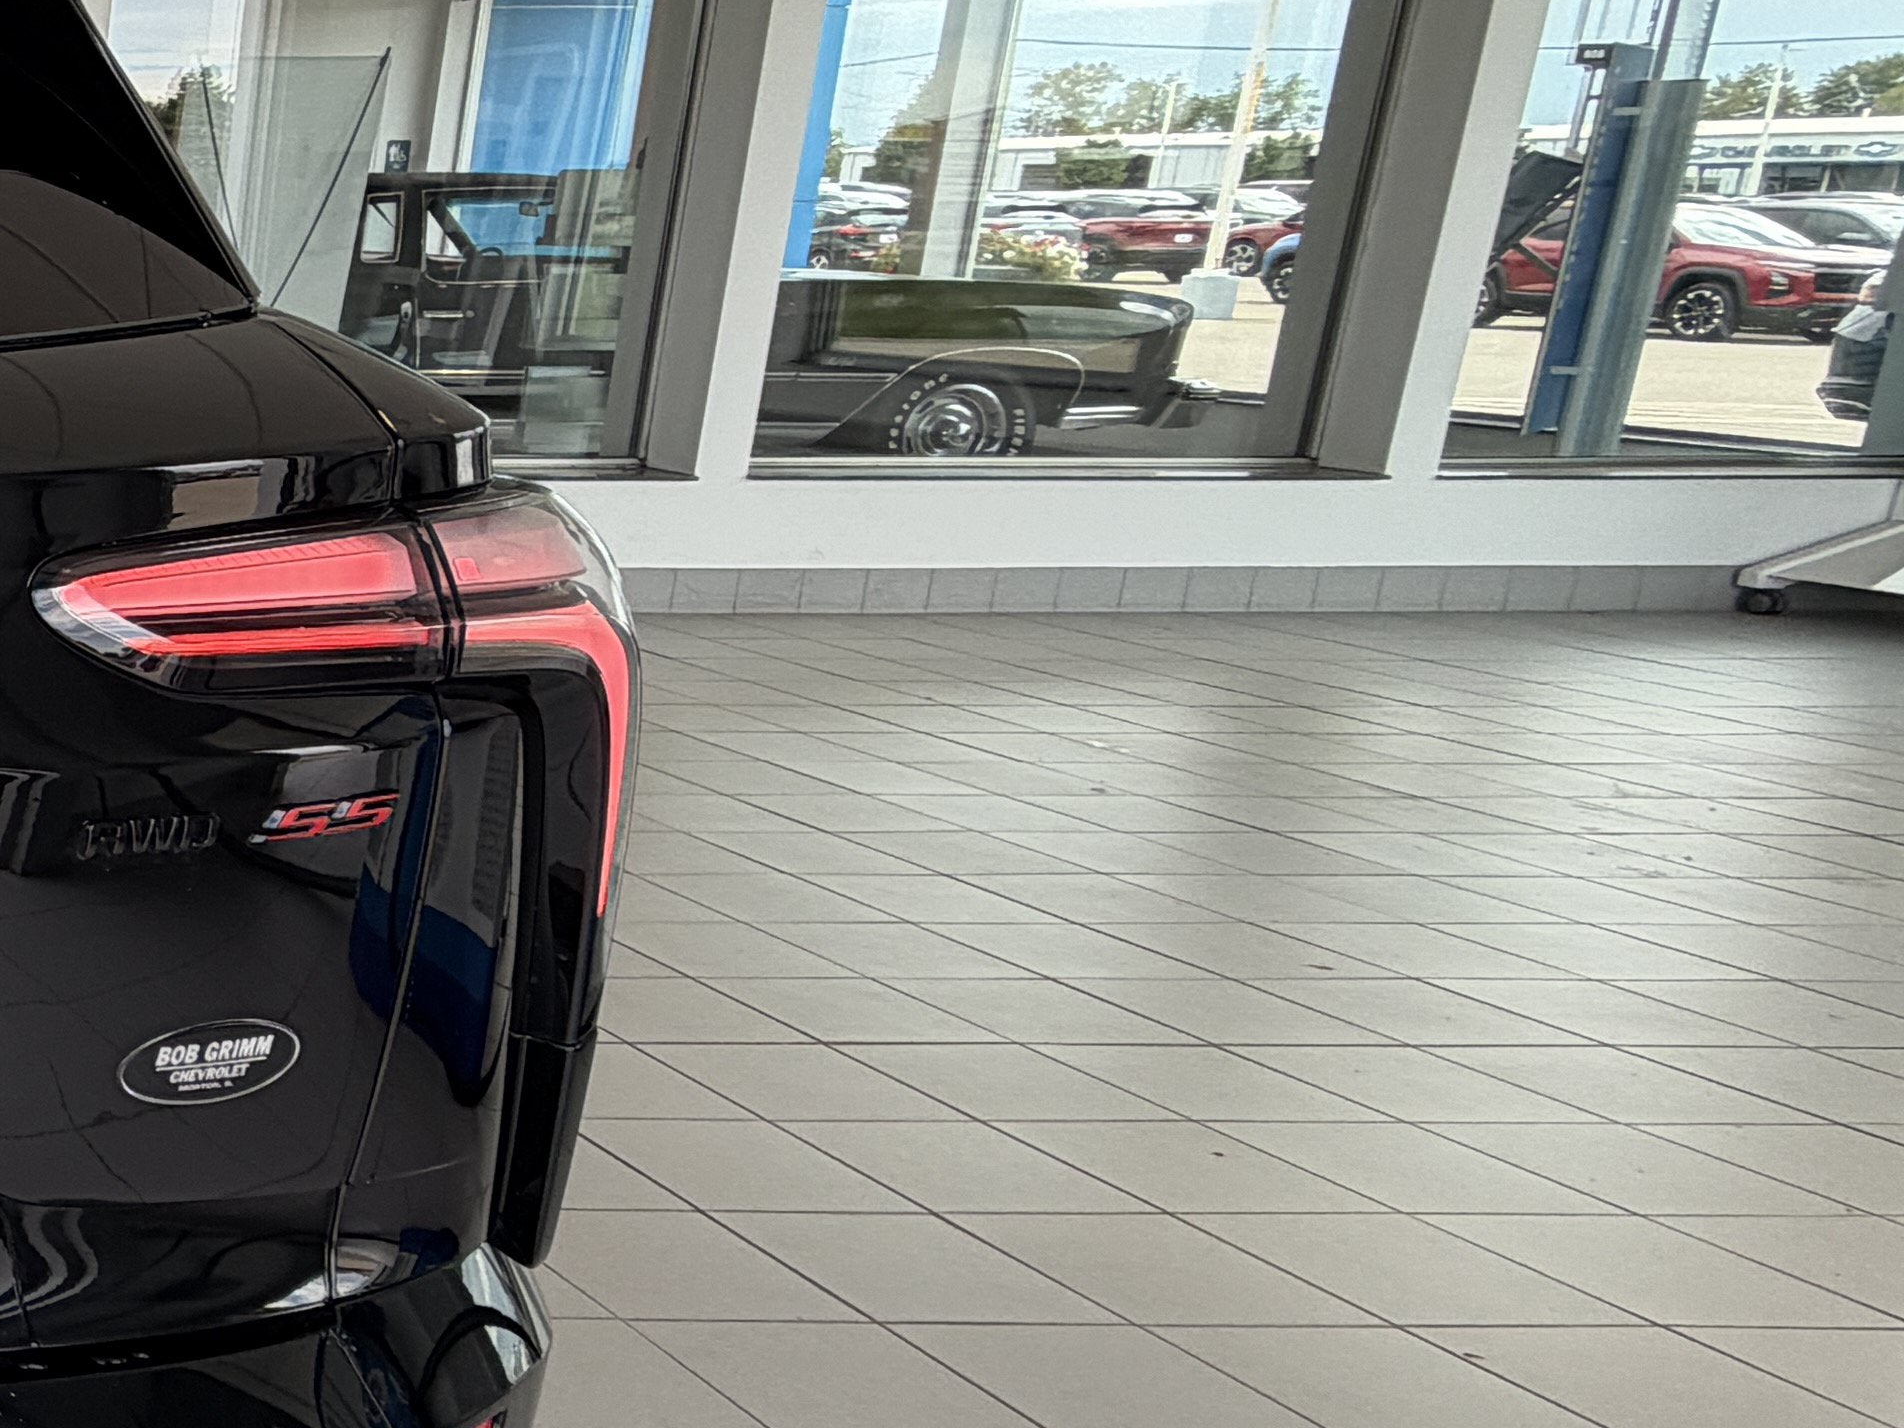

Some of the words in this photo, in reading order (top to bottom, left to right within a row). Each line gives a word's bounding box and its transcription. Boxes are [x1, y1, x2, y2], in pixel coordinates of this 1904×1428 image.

[246, 790, 401, 845] SS
[154, 1043, 201, 1067] BOB
[204, 1034, 276, 1062] GRIMM
[168, 1063, 251, 1084] CHEVROLET
